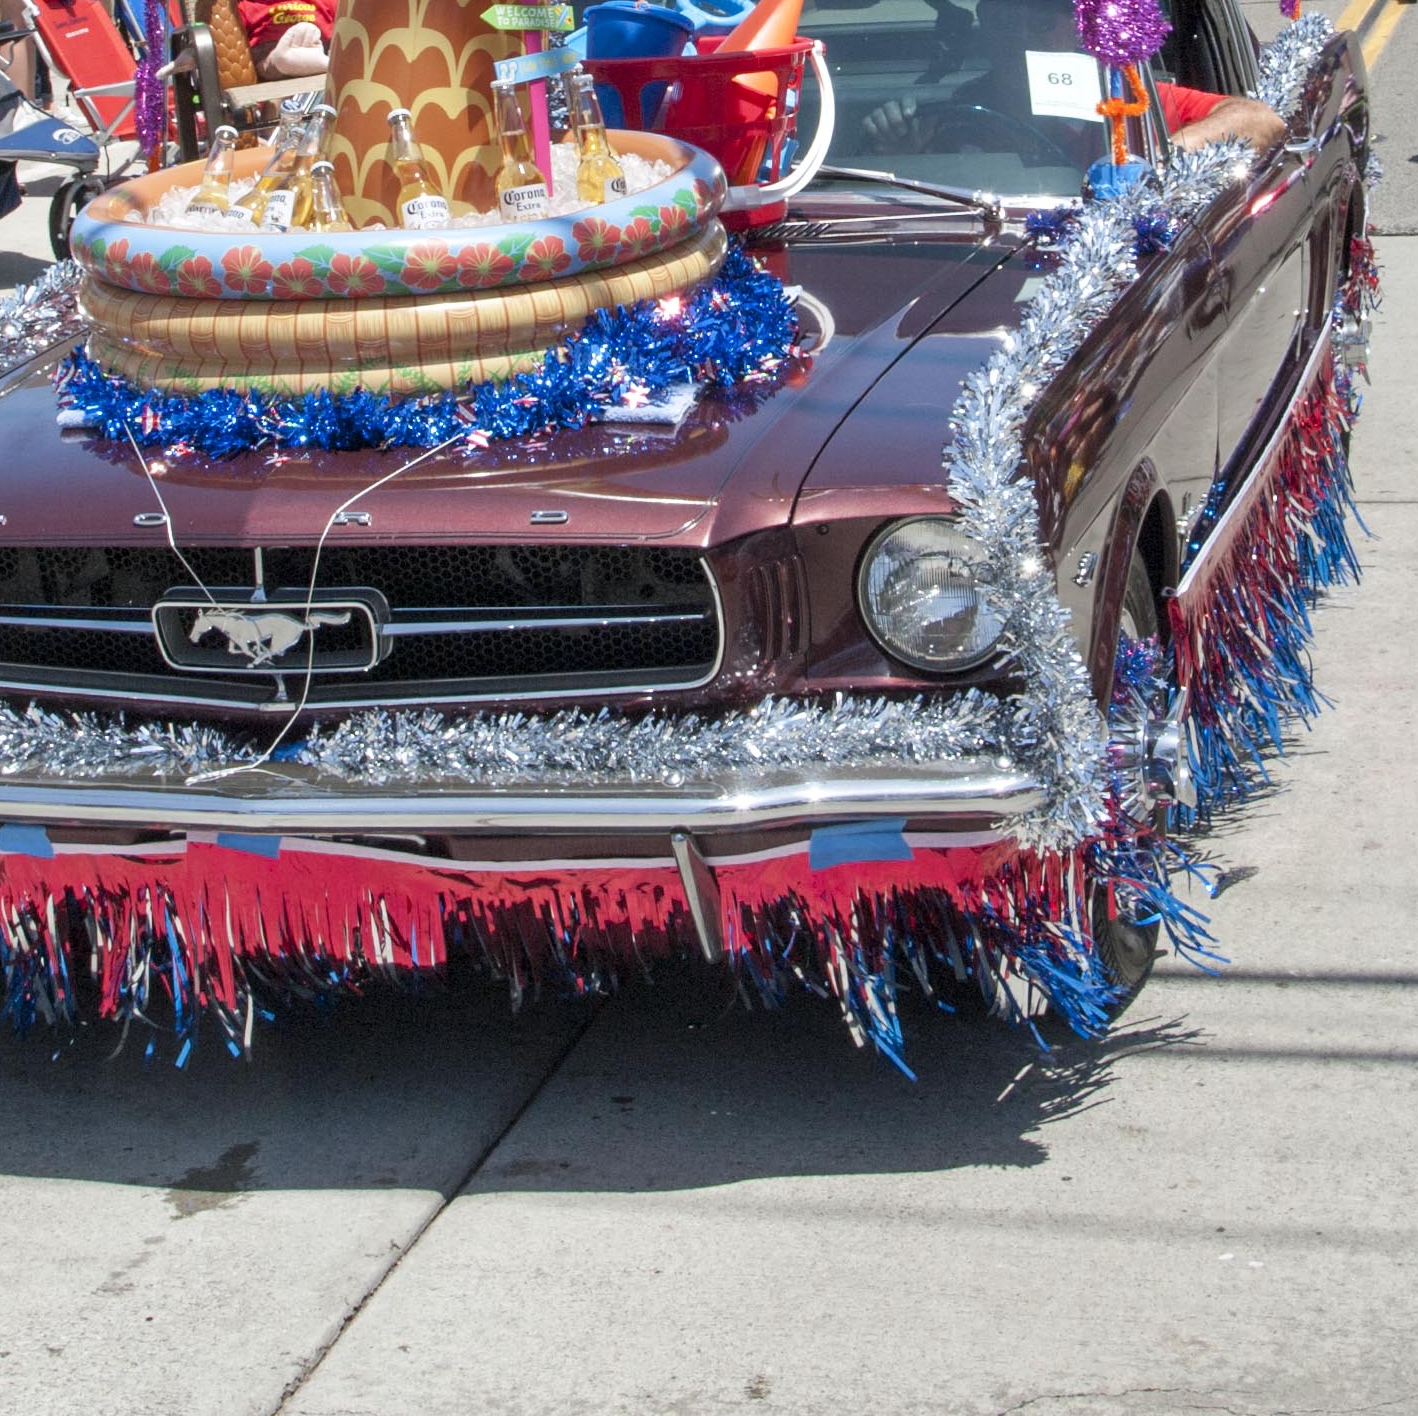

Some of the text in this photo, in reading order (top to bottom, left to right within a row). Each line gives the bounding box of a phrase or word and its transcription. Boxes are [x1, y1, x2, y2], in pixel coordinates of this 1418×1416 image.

[495, 6, 555, 18] WELCOME
[496, 16, 556, 27] TO PARADISE
[1047, 72, 1073, 86] 68
[503, 187, 546, 205] Corona
[407, 199, 448, 215] Corona
[516, 202, 541, 212] Extra
